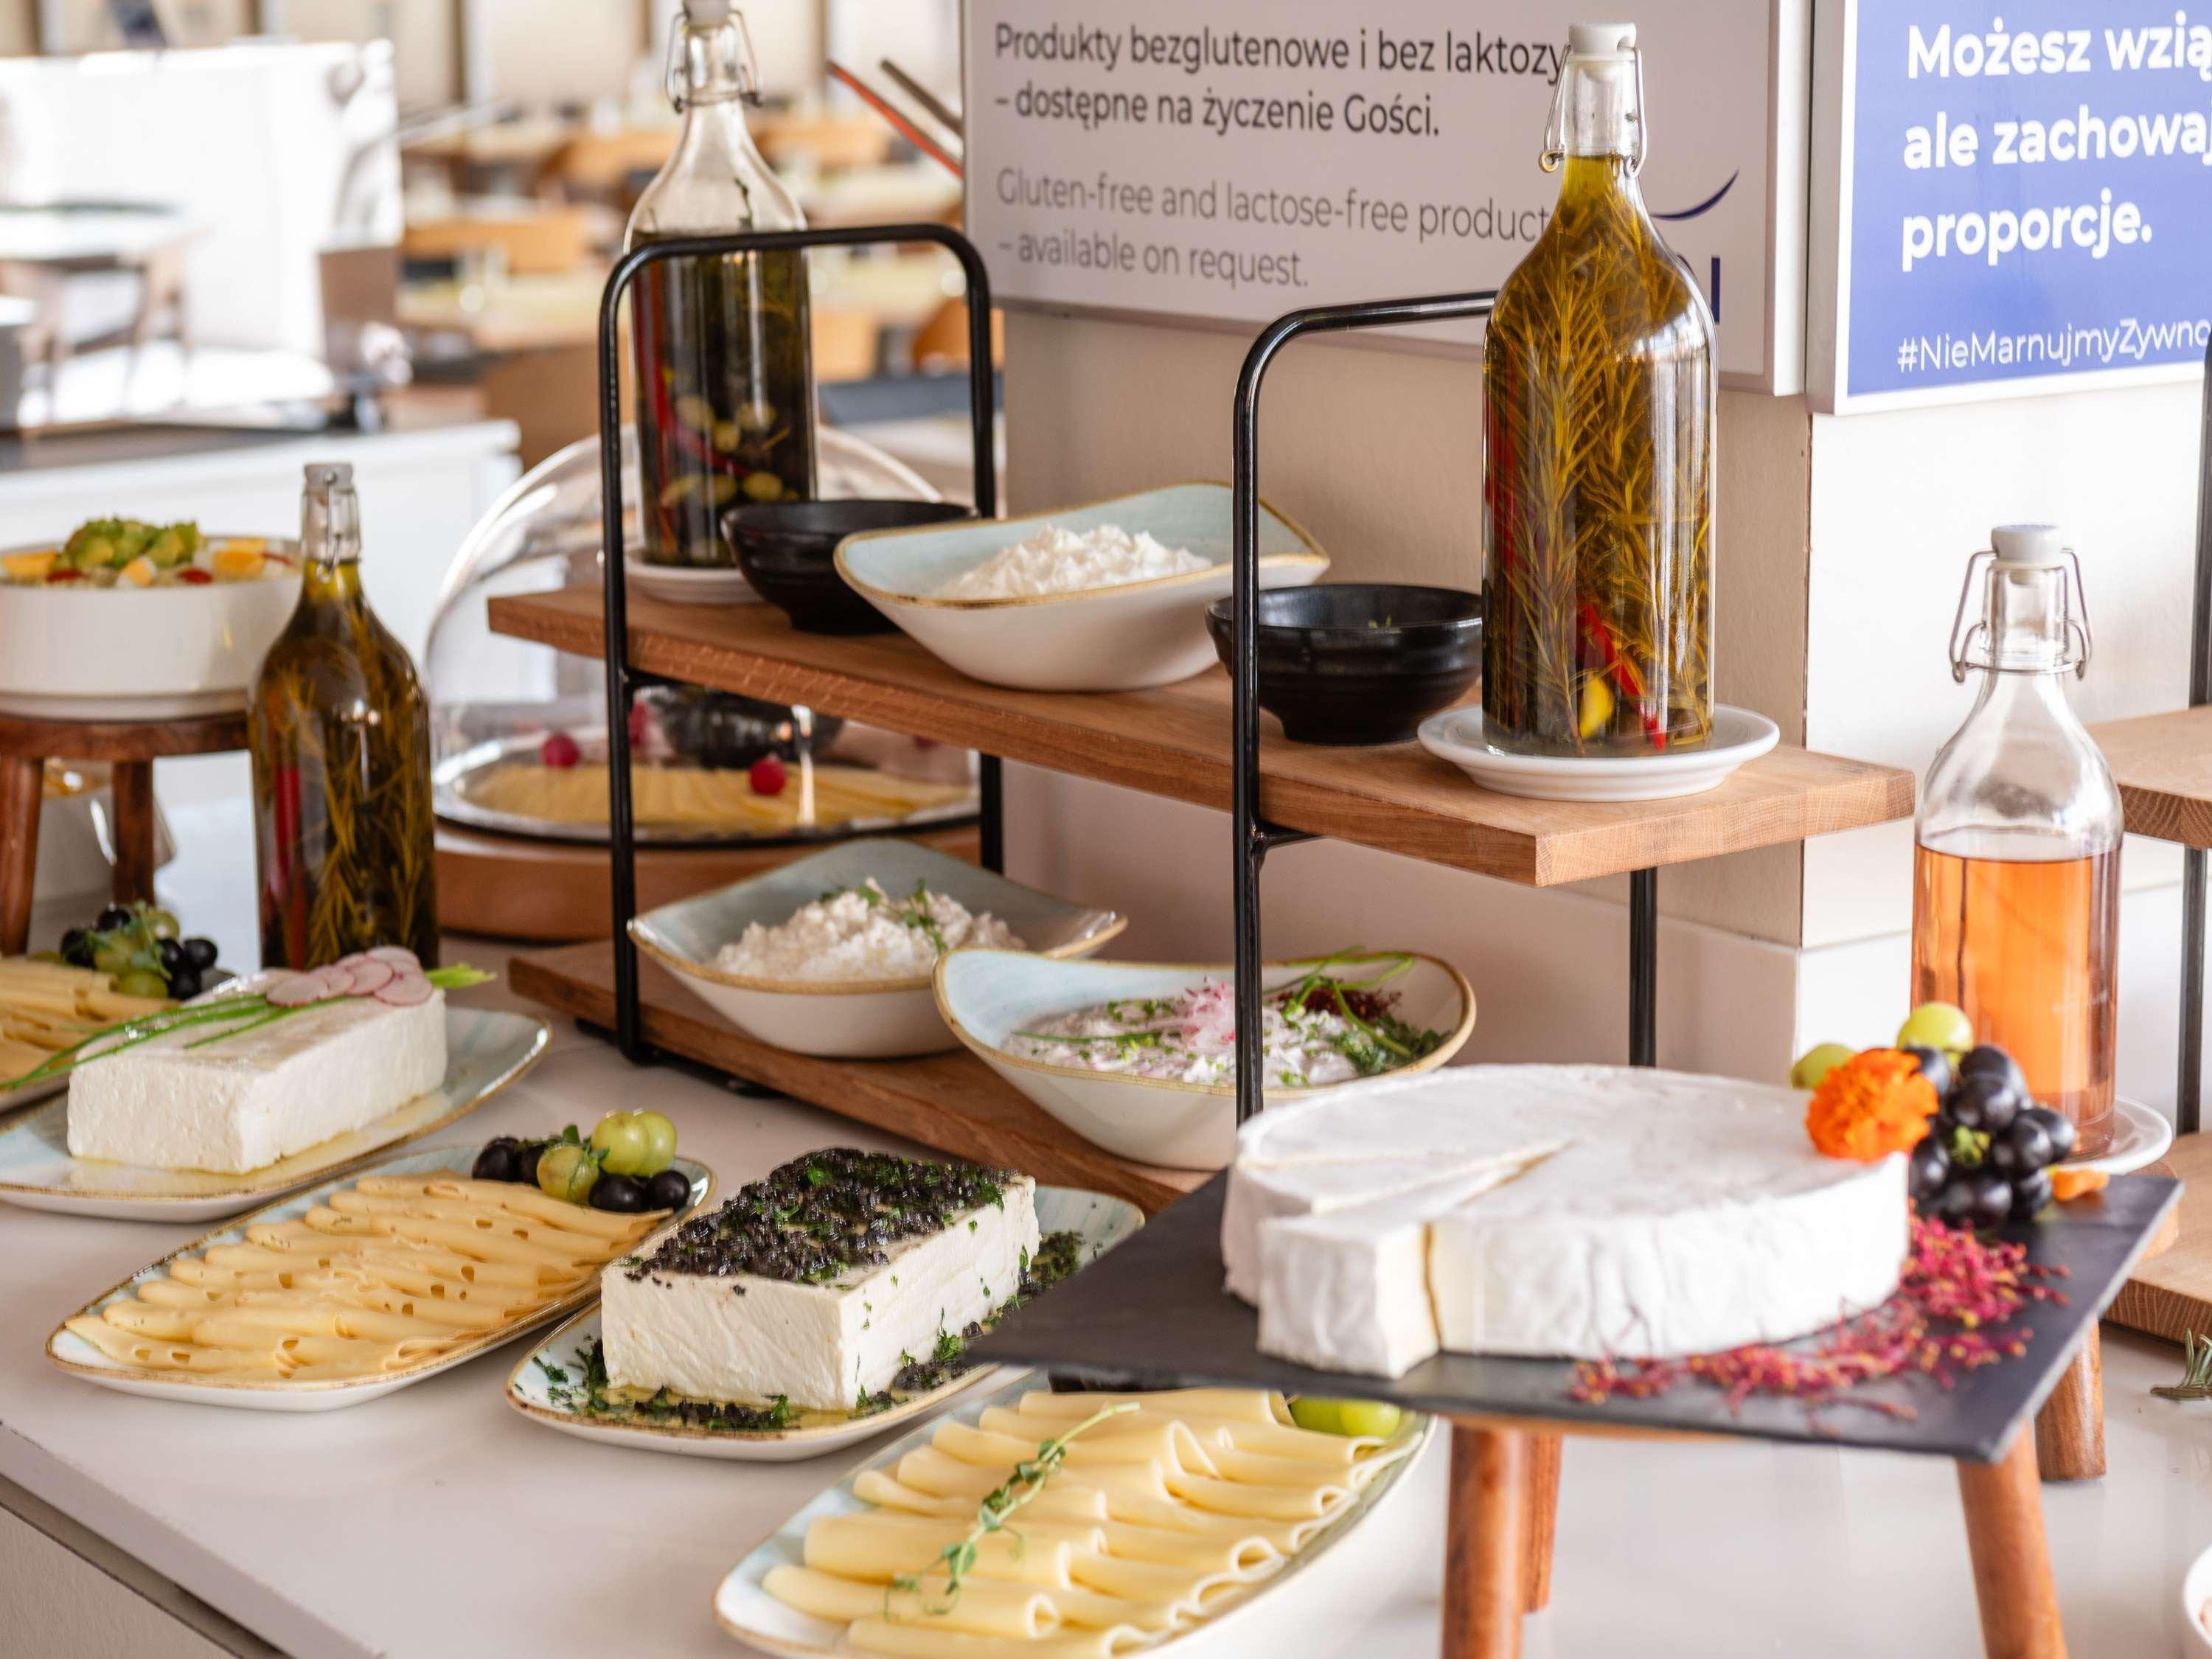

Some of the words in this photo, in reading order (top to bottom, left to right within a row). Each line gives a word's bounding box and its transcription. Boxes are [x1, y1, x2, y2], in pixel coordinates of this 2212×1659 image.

[995, 22, 1121, 72] Produkty
[1130, 24, 1349, 74] bezglutenowe
[1360, 27, 1367, 69] i
[1379, 29, 1435, 72] bez
[1447, 31, 1566, 86] laktozy
[1907, 16, 2092, 79] Możesz
[1015, 80, 1148, 131] dostępne
[1158, 94, 1192, 124] na
[1203, 87, 1333, 136] życzenie
[1344, 94, 1439, 136] Gości.
[1903, 111, 1979, 170] ale
[997, 167, 1153, 215] Gluten-free
[1162, 181, 1217, 220] and
[1227, 181, 1408, 233] lactose-free
[1902, 187, 2153, 273] proporcje.
[1018, 229, 1135, 272] available
[1144, 245, 1179, 274] on
[1189, 246, 1308, 288] request.
